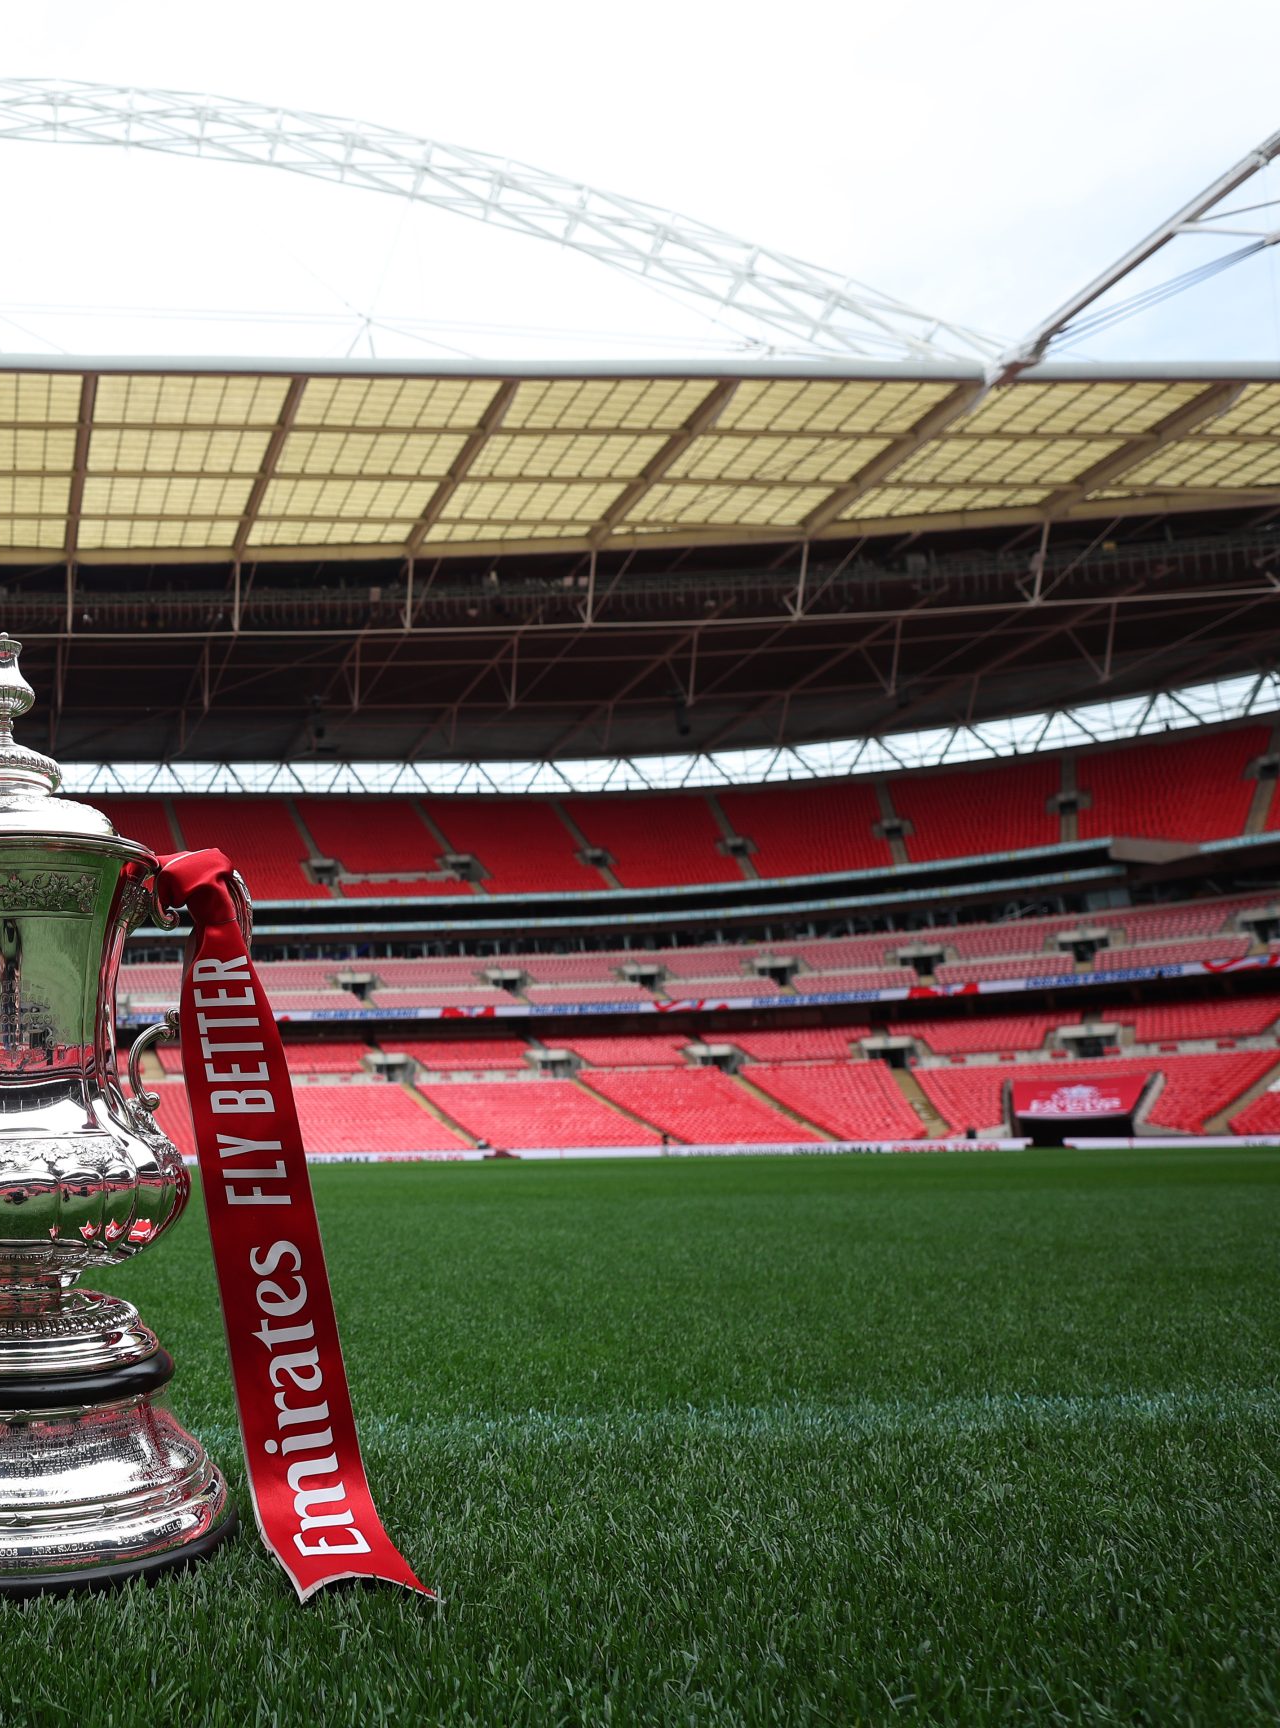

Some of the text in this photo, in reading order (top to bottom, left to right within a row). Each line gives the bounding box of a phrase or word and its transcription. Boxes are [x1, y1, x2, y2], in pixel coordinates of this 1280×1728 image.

[192, 955, 371, 1557] Emirates FLY BETTER
[31, 1541, 97, 1556] PORTSMOUTH
